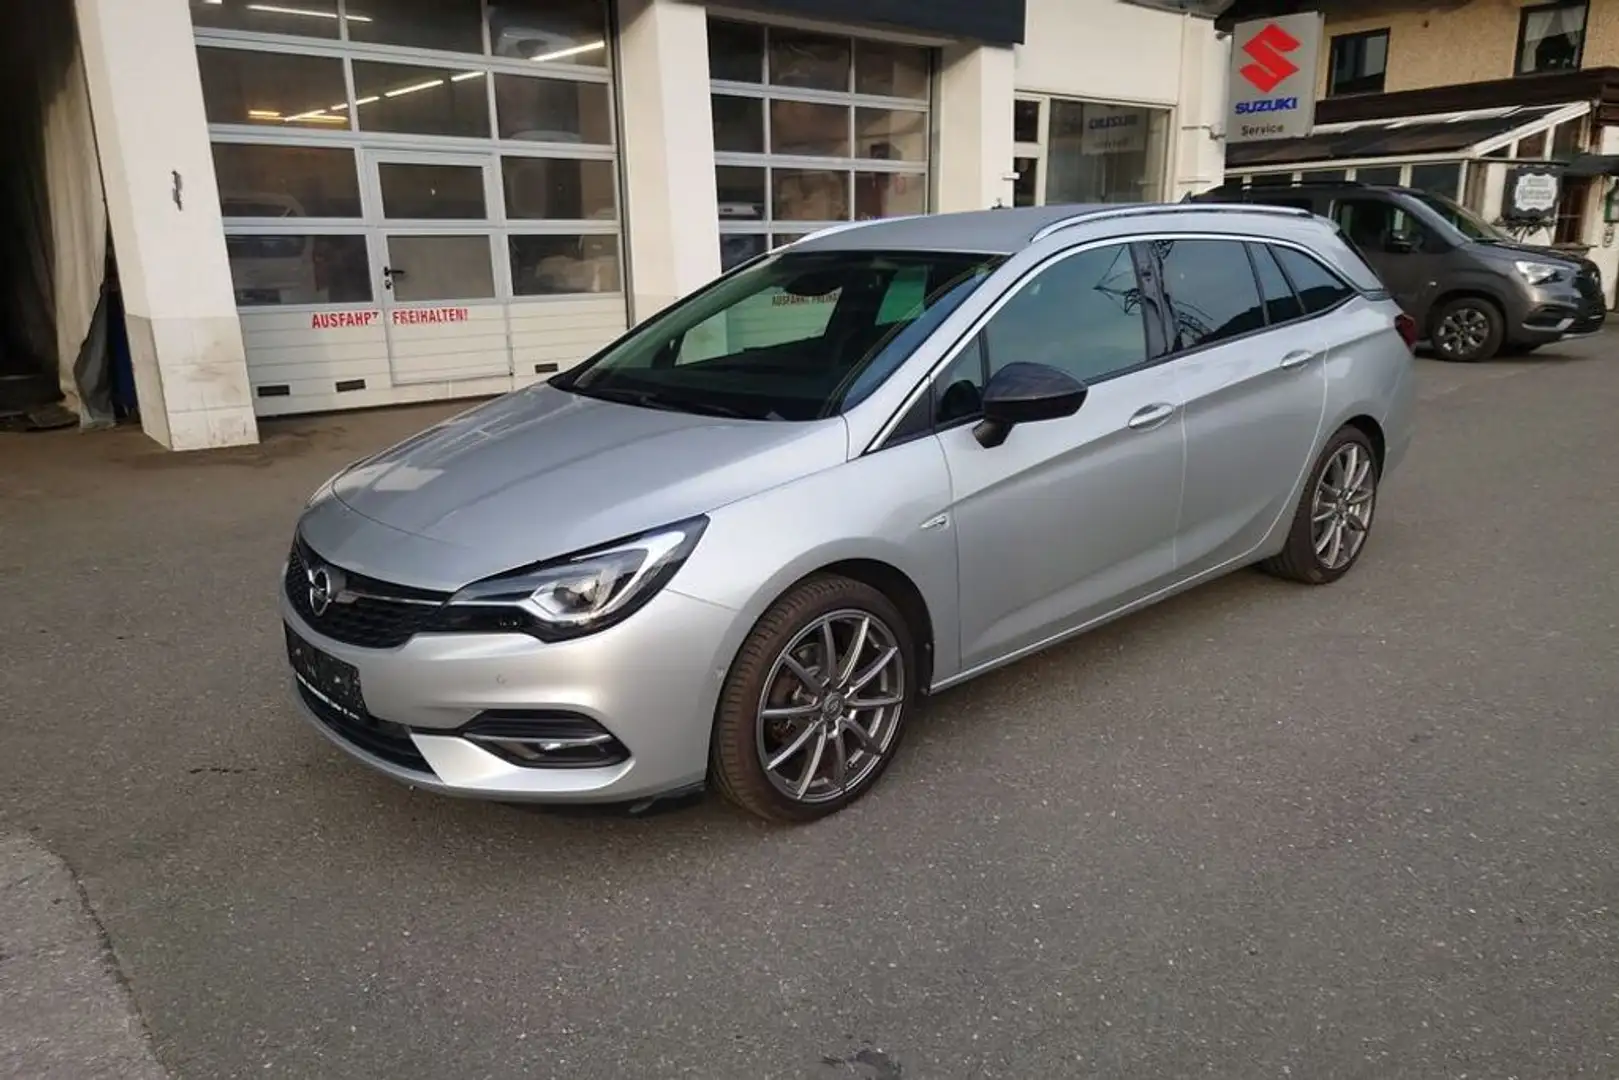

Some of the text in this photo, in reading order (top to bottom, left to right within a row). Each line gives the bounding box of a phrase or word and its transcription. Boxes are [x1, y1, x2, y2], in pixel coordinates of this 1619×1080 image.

[1235, 97, 1297, 114] SUZUKI
[1241, 124, 1285, 136] Service
[393, 308, 469, 325] FREIHALTEN!
